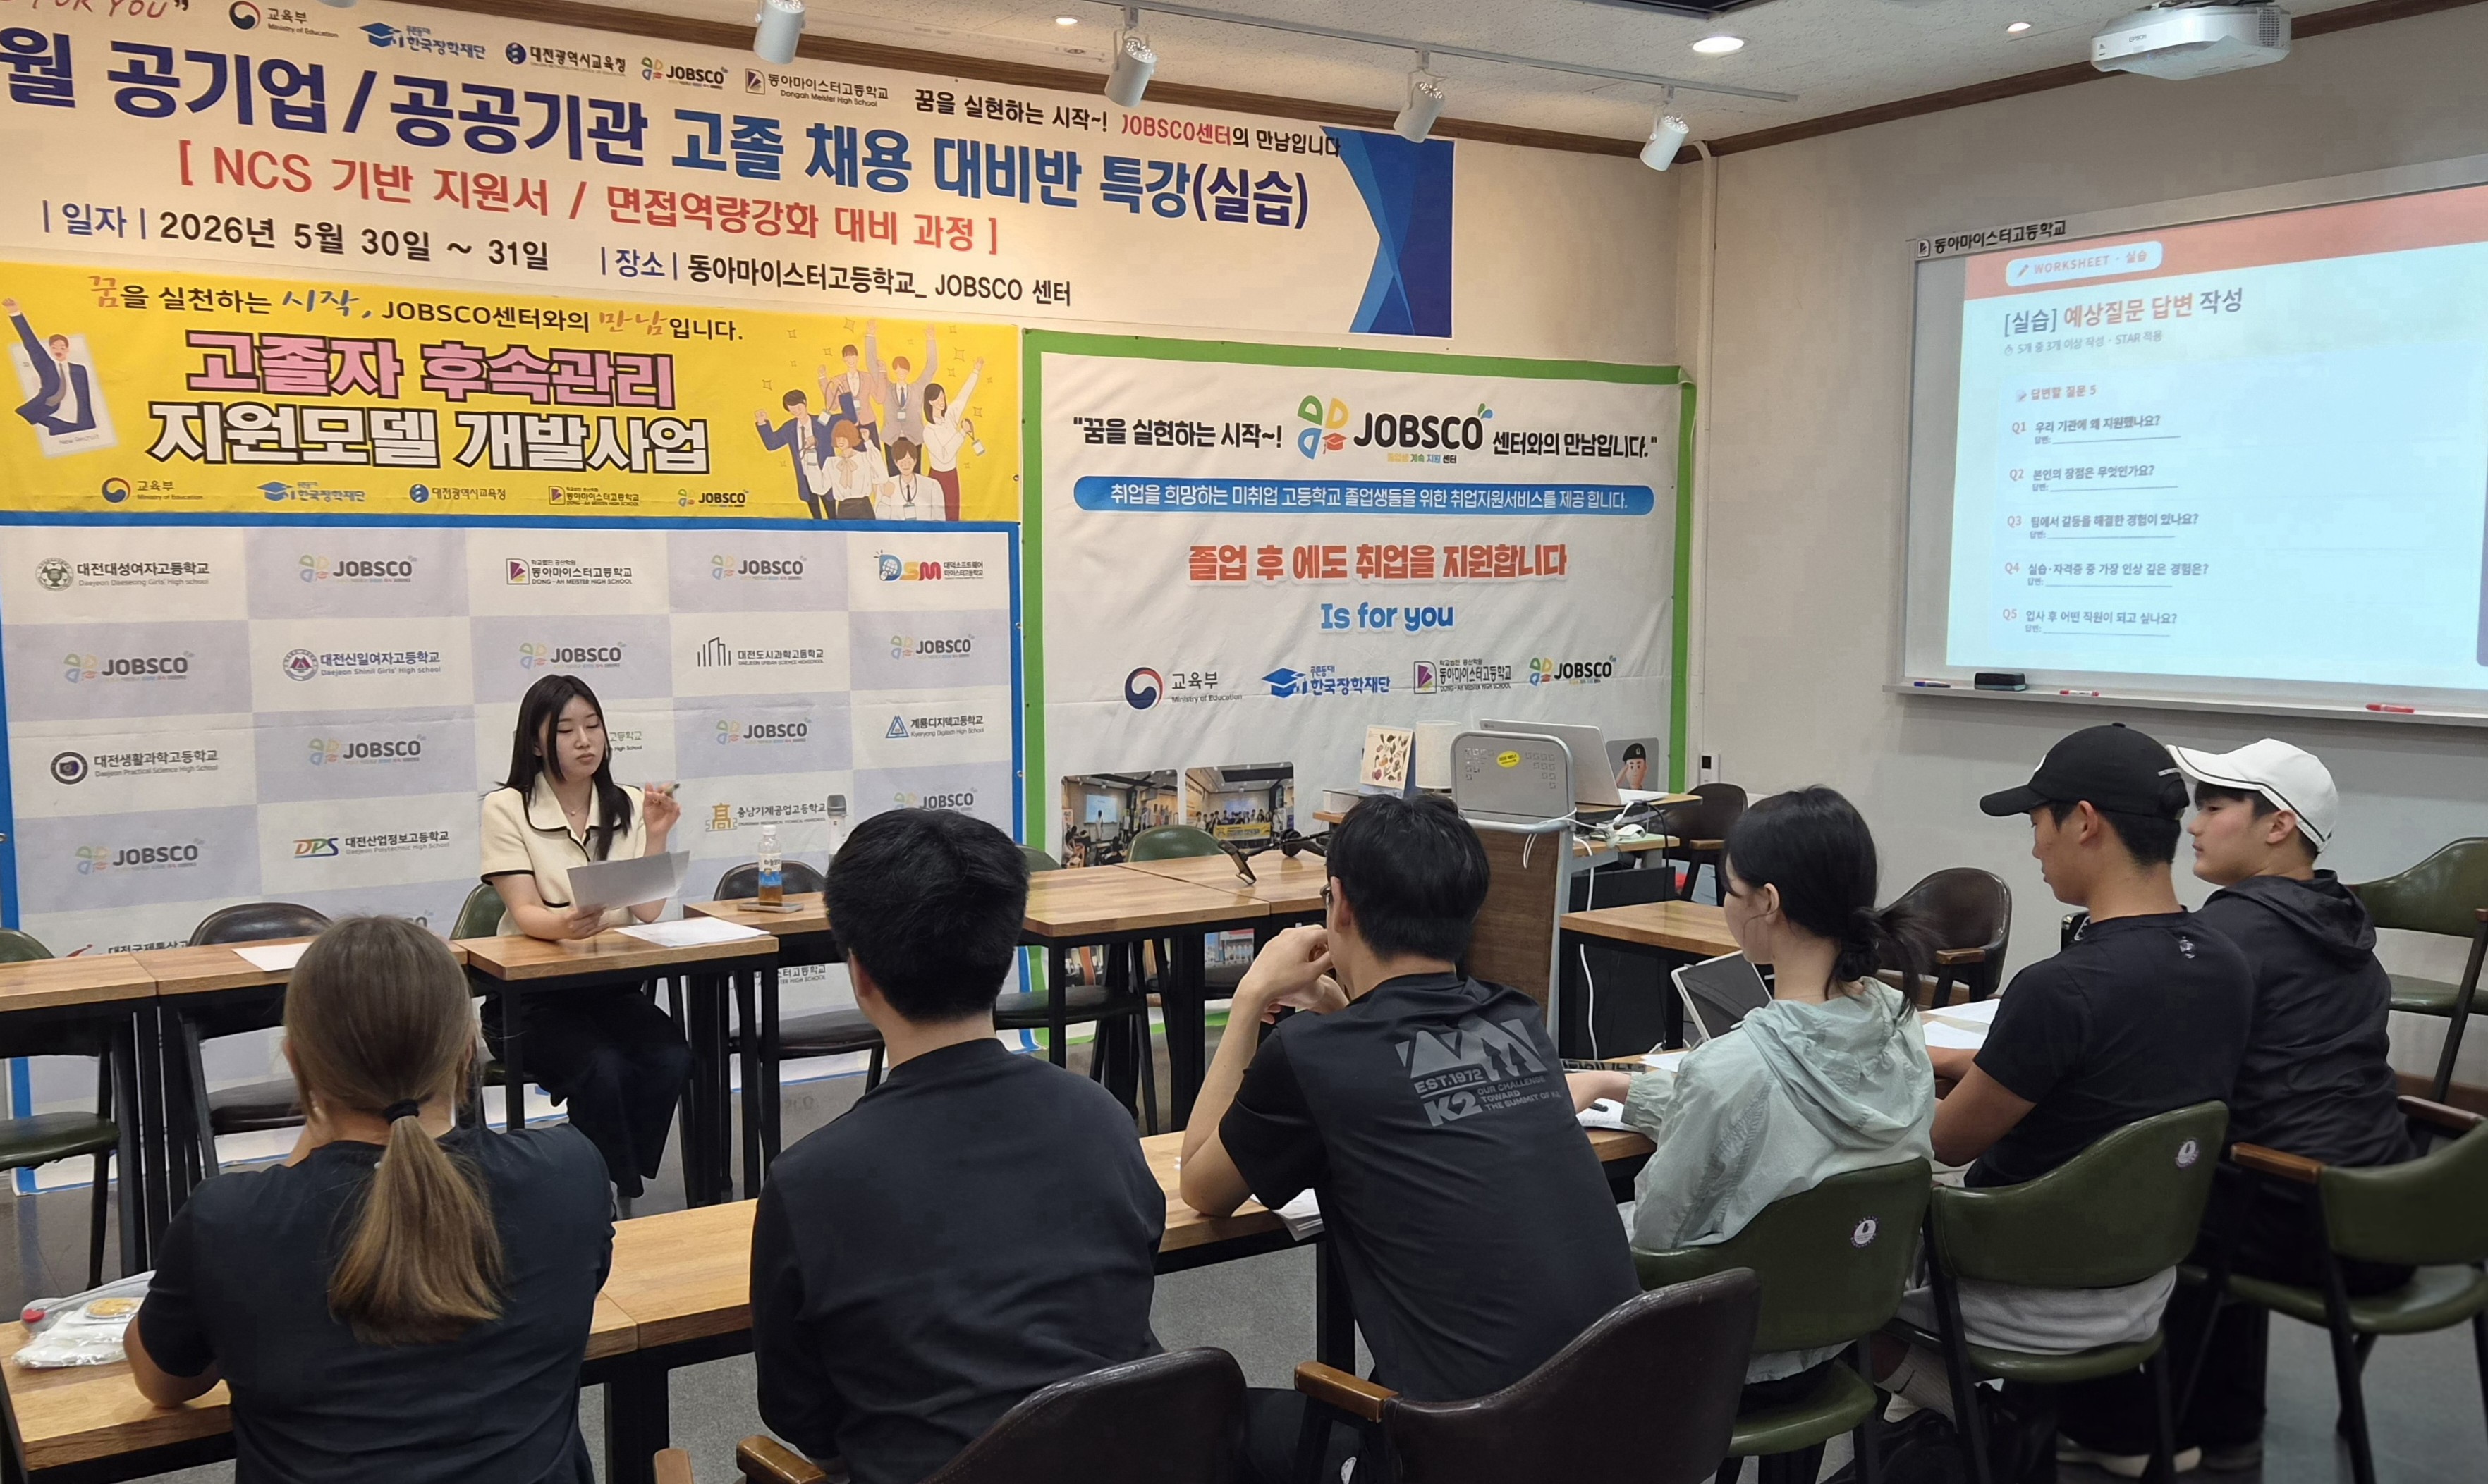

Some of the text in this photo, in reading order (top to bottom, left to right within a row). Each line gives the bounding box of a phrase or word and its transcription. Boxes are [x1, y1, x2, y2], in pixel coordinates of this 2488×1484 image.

[267, 8, 307, 23] 교육부
[407, 36, 486, 59] 한국장학재단
[530, 47, 626, 72] 대전광역시교육청
[666, 66, 724, 85] JOBSCO
[768, 73, 888, 99] 동아마이스터고등학교
[781, 90, 877, 107] Dongah Meister High School
[915, 88, 1341, 159] 꿈을 실현하는 시작~! JOBSCO센터의 만남입니다
[108, 39, 1309, 230] 공기업 공공기관 고졸 채용 대비반 특강(실습)
[214, 146, 973, 252] NCS 기반 지원서 면접역량강화 대비 과정
[159, 211, 549, 271] 2026년 5월 30일 31일
[1934, 220, 2066, 253] 동아마이스터고등학교
[2034, 255, 2110, 274] WORKSHEET
[2126, 250, 2147, 264] 실습
[934, 273, 1023, 301] JOBSCO
[1032, 278, 1071, 307] 센터
[89, 276, 743, 341] 꿈을 실천하는 시작, JOBSCO센터와의 만남입니다.
[2004, 287, 2243, 337] [실습] 예상질문 답변 작성
[2115, 330, 2163, 345] STAR 적용
[185, 329, 675, 411] 고졸자 후속관리
[2030, 385, 2097, 400] 답변할 질문 5
[2012, 422, 2026, 434] Q1
[2035, 420, 2054, 434] 우리
[2057, 419, 2087, 432] 기관에
[2090, 418, 2100, 430] 왜
[145, 400, 709, 474] 지원모델 개발사업
[1073, 412, 1657, 458] "꿈을 실현하는 시작~! JOBSCO 센터와의 만남입니다."
[2010, 470, 2024, 482] Q2
[2033, 465, 2154, 481] 본인의 장점은 무엇인가요?
[137, 481, 174, 492] 교육부
[432, 487, 506, 501] 대전광역시교육청
[298, 489, 365, 502] 한국장학재단
[567, 493, 639, 501] 동아마이스터고등학교
[698, 492, 745, 504] JOBSCO
[1111, 484, 1628, 509] 취업을 희망하는 미취업 고등학교 졸업생들을 위한 취업지원서비스를 제공 합니다.
[2007, 516, 2022, 528] Q3
[2031, 513, 2199, 528] 팀에서 갈등을 해결한 경험이 있나요?
[77, 562, 209, 576] 대전대성여자고등학교
[333, 561, 412, 578] JOBSCO
[738, 560, 803, 575] JOBSCO
[879, 554, 941, 581] DSM
[1189, 543, 1566, 582] 졸업 후 에도 취업을 지원합니다
[2005, 563, 2020, 575] Q4
[2086, 563, 2096, 575] 중
[2099, 564, 2118, 575] 가장
[2122, 564, 2142, 575] 인상
[2146, 563, 2166, 575] 깊은
[2170, 563, 2209, 575] 경험은?
[532, 567, 632, 578] 동아마이스터고등학교
[1320, 602, 1453, 629] Is for you
[2003, 609, 2017, 620] Q5
[2026, 611, 2177, 625] 입사 후 어떤 직원이 되고 싶나요?
[551, 646, 621, 663] JOBSCO
[738, 649, 824, 659] 대전도시과학고등학교
[915, 639, 970, 654] JOBSCO
[102, 656, 188, 676] JOBSCO
[320, 651, 440, 666] 대전신일여자고등학교
[321, 668, 351, 676] Daejeon
[399, 667, 415, 675] High
[1439, 665, 1511, 684] 동아마이스터고등학교
[1554, 662, 1611, 679] JOBSCO
[1172, 672, 1219, 690] 교육부
[1311, 676, 1391, 696] 한국장학재단
[1171, 694, 1198, 704] Ministry
[910, 716, 983, 728] 계룡디지텍고등학교
[743, 723, 807, 739] JOBSCO
[343, 740, 421, 759] JOBSCO
[94, 749, 218, 768] 대전생활과학고등학교
[920, 793, 974, 809] JOBSCO
[737, 803, 826, 818] 충남기계공업고등학교
[293, 837, 339, 858] DPS
[345, 830, 449, 848] 대전산업정보고등학교
[113, 845, 197, 866] JOBSCO
[1414, 1069, 1483, 1093] EST.1972
[1477, 1075, 1546, 1096] OUR CHALLENGE
[1481, 1089, 1520, 1103] TOWARD
[1484, 1095, 1539, 1111] THE SUMMIT
[1423, 1091, 1483, 1127] K2
